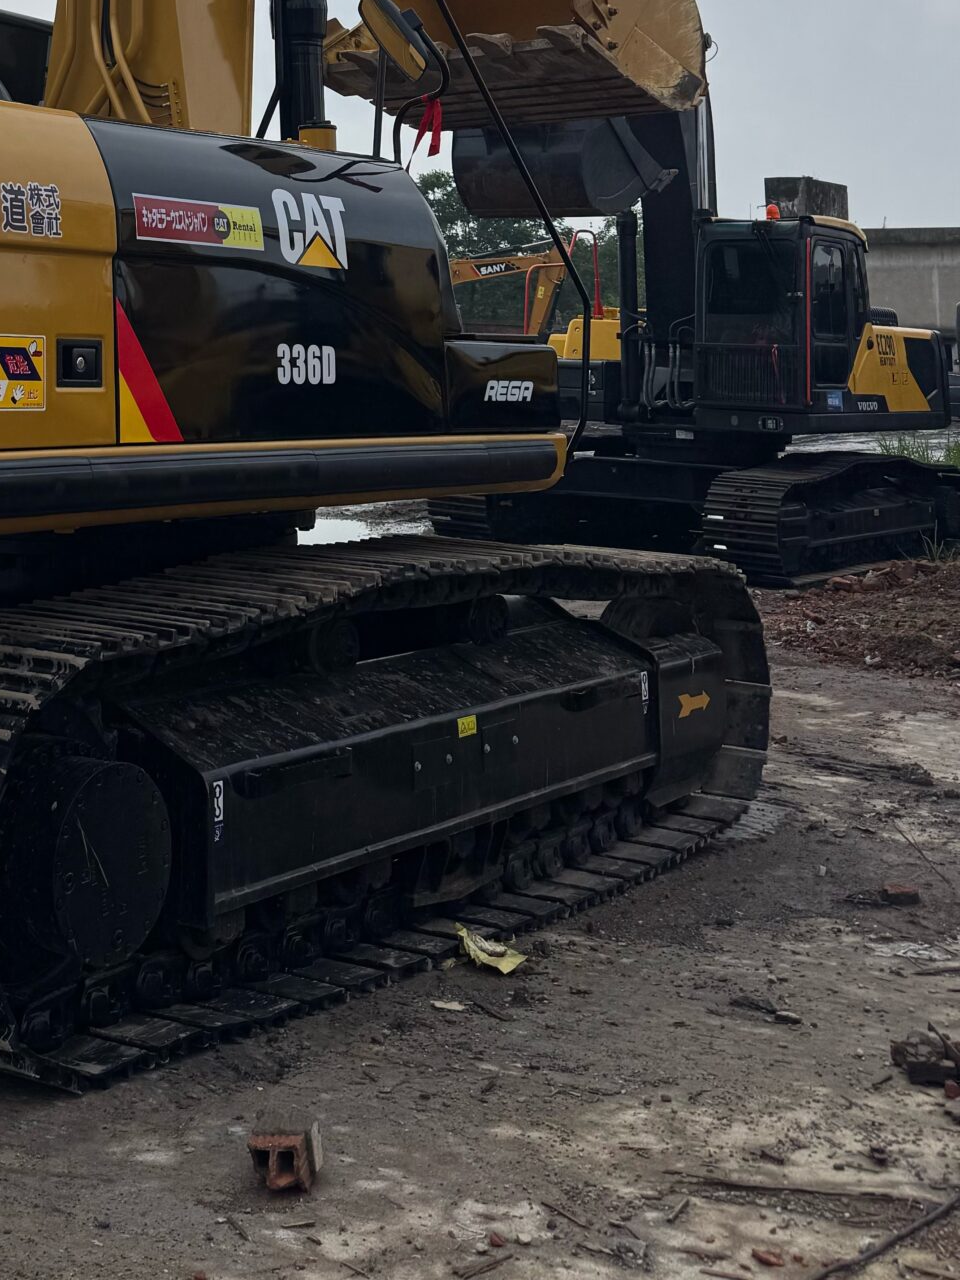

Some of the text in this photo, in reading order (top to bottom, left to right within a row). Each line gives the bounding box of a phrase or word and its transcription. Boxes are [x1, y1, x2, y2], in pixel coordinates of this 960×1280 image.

[214, 217, 256, 232] CAT Rental
[271, 188, 348, 270] CAT
[480, 263, 506, 275] SANY
[277, 343, 336, 385] 336D
[484, 380, 534, 402] REGA
[857, 401, 878, 411] VOLVO
